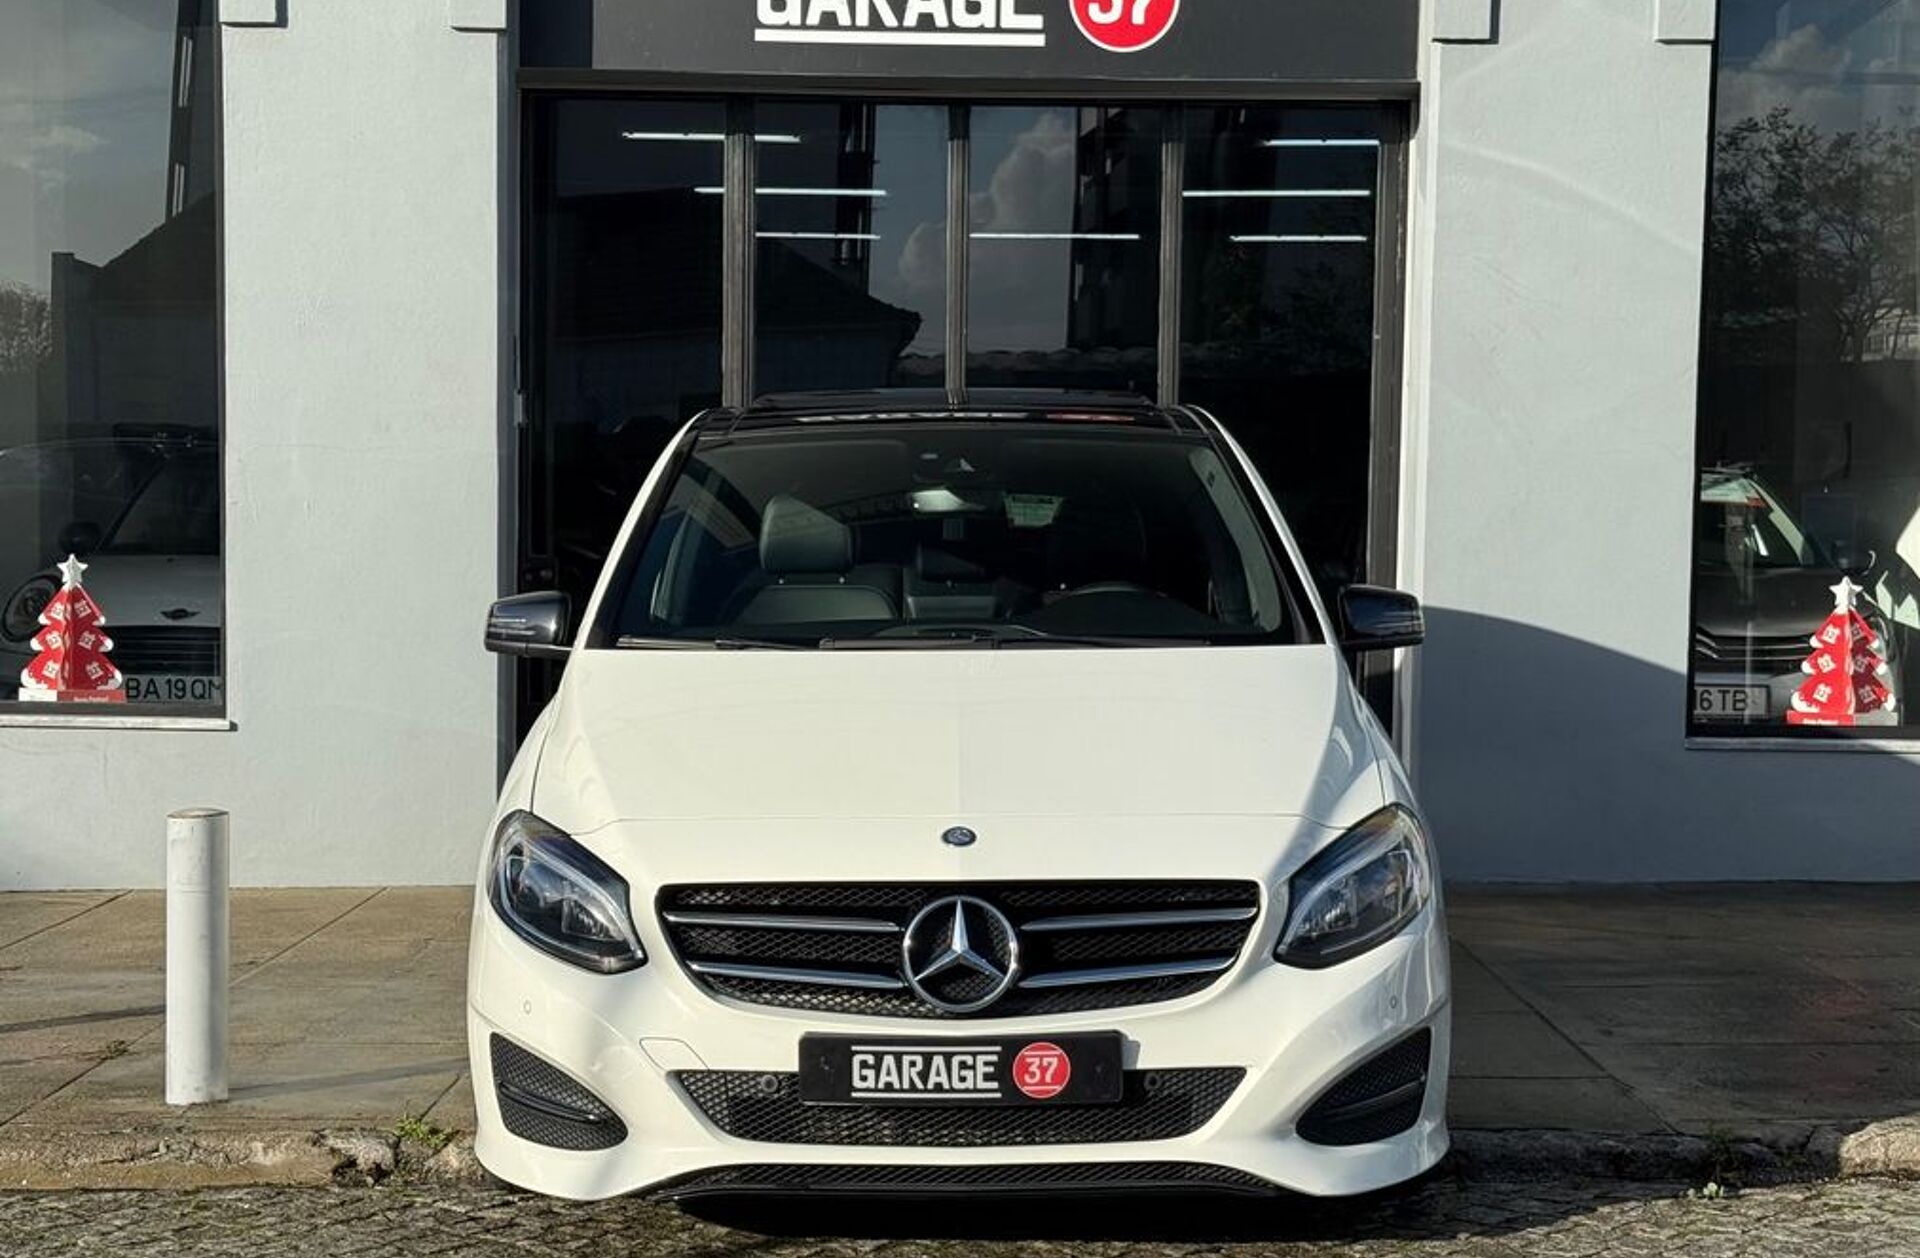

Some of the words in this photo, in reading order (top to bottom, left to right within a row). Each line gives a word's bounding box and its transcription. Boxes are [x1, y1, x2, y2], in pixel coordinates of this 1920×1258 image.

[125, 678, 160, 699] BA
[165, 678, 187, 700] 19
[1717, 689, 1748, 712] TB
[852, 1054, 999, 1090] GARAGE
[1024, 1057, 1059, 1084] 37
